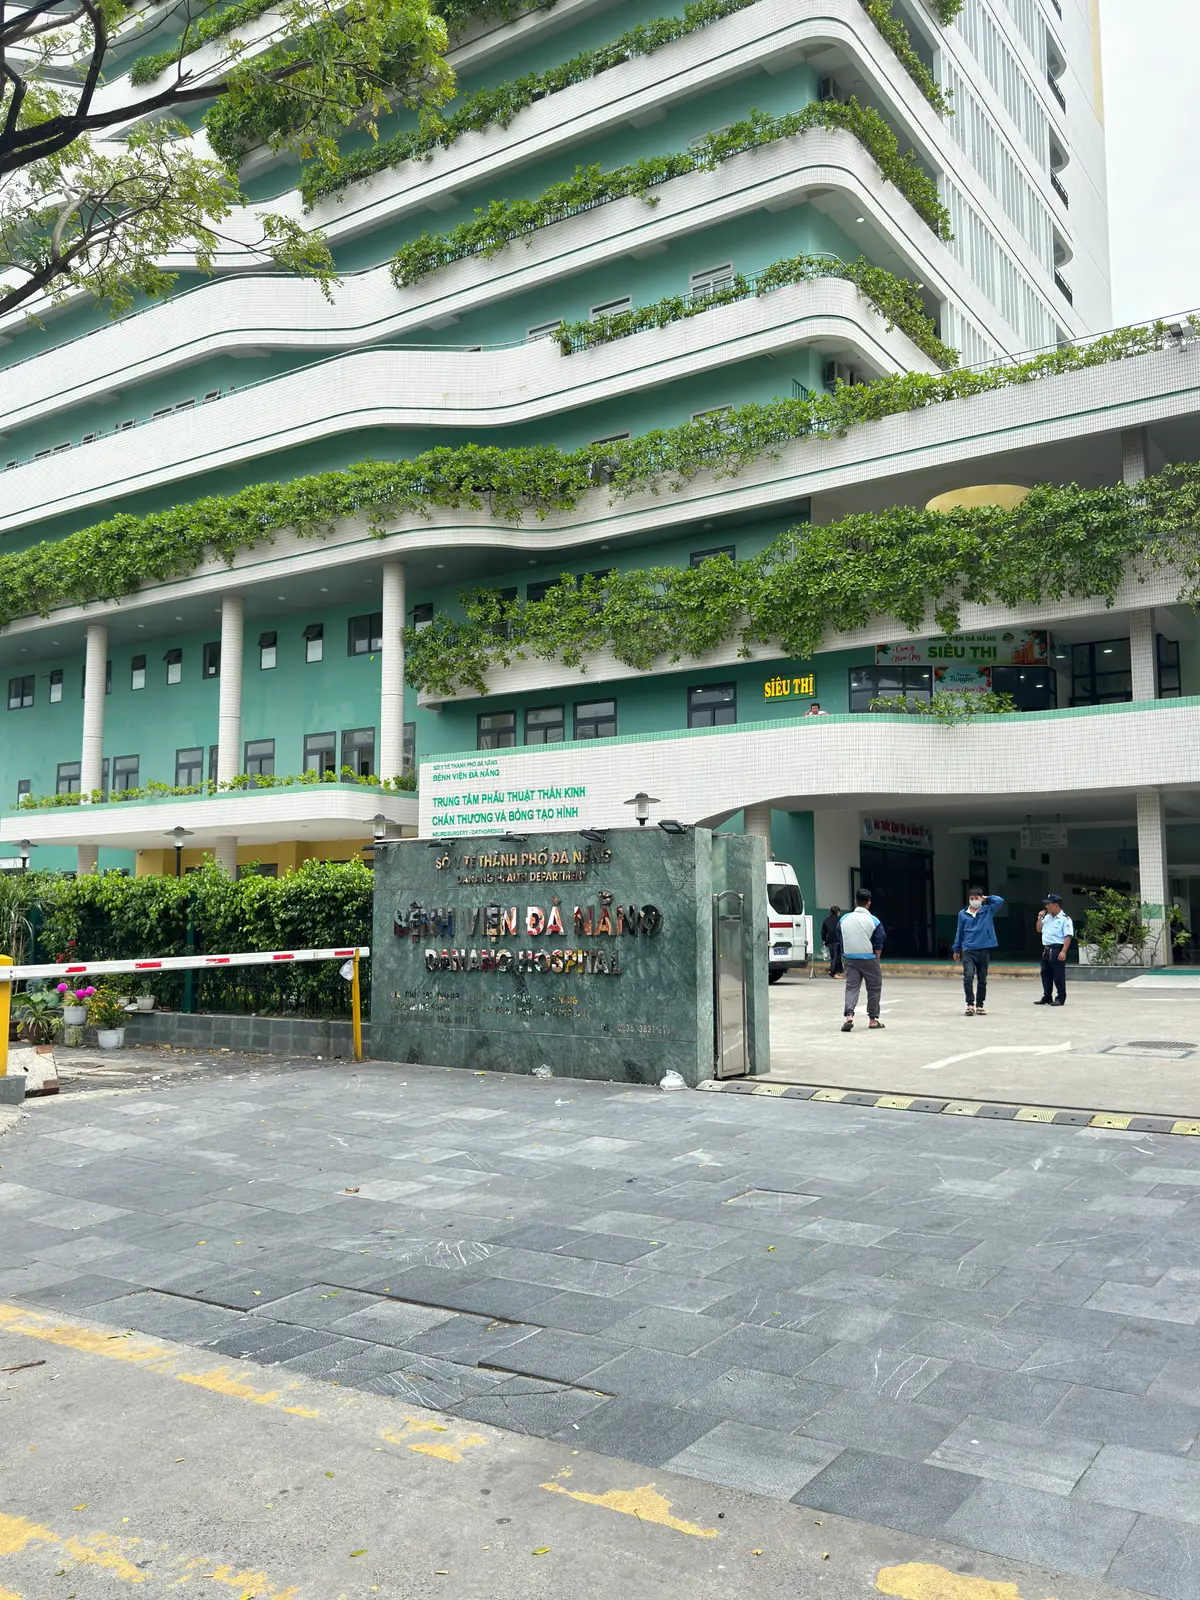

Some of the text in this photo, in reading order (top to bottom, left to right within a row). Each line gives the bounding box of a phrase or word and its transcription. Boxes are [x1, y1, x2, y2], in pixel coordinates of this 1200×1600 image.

[927, 643, 966, 658] SIÊU
[969, 646, 997, 661] THỊ
[764, 673, 814, 697] SIÊU THỊ
[432, 772, 451, 783] BỆNH
[452, 770, 467, 781] VIỆN
[468, 769, 479, 779] ĐÀ
[432, 795, 460, 807] TRUNG
[462, 792, 480, 806] TÂM
[507, 789, 536, 803] THUẬT
[564, 786, 587, 798] KINH
[457, 811, 493, 825] THƯƠNG
[494, 809, 507, 822] VÀ
[536, 808, 555, 822] TẠO
[556, 805, 579, 819] HÌNH
[435, 852, 451, 869] SỞ
[478, 850, 518, 868] THÀNH
[520, 847, 548, 865] PHỐ
[550, 848, 570, 865] ĐÀ
[529, 870, 588, 882] DEPARTMENT
[466, 898, 518, 943] VIỆN
[525, 893, 567, 937] ĐÀ
[573, 890, 664, 937] NẴNG
[424, 948, 622, 976] DANANG HOSPITAL
